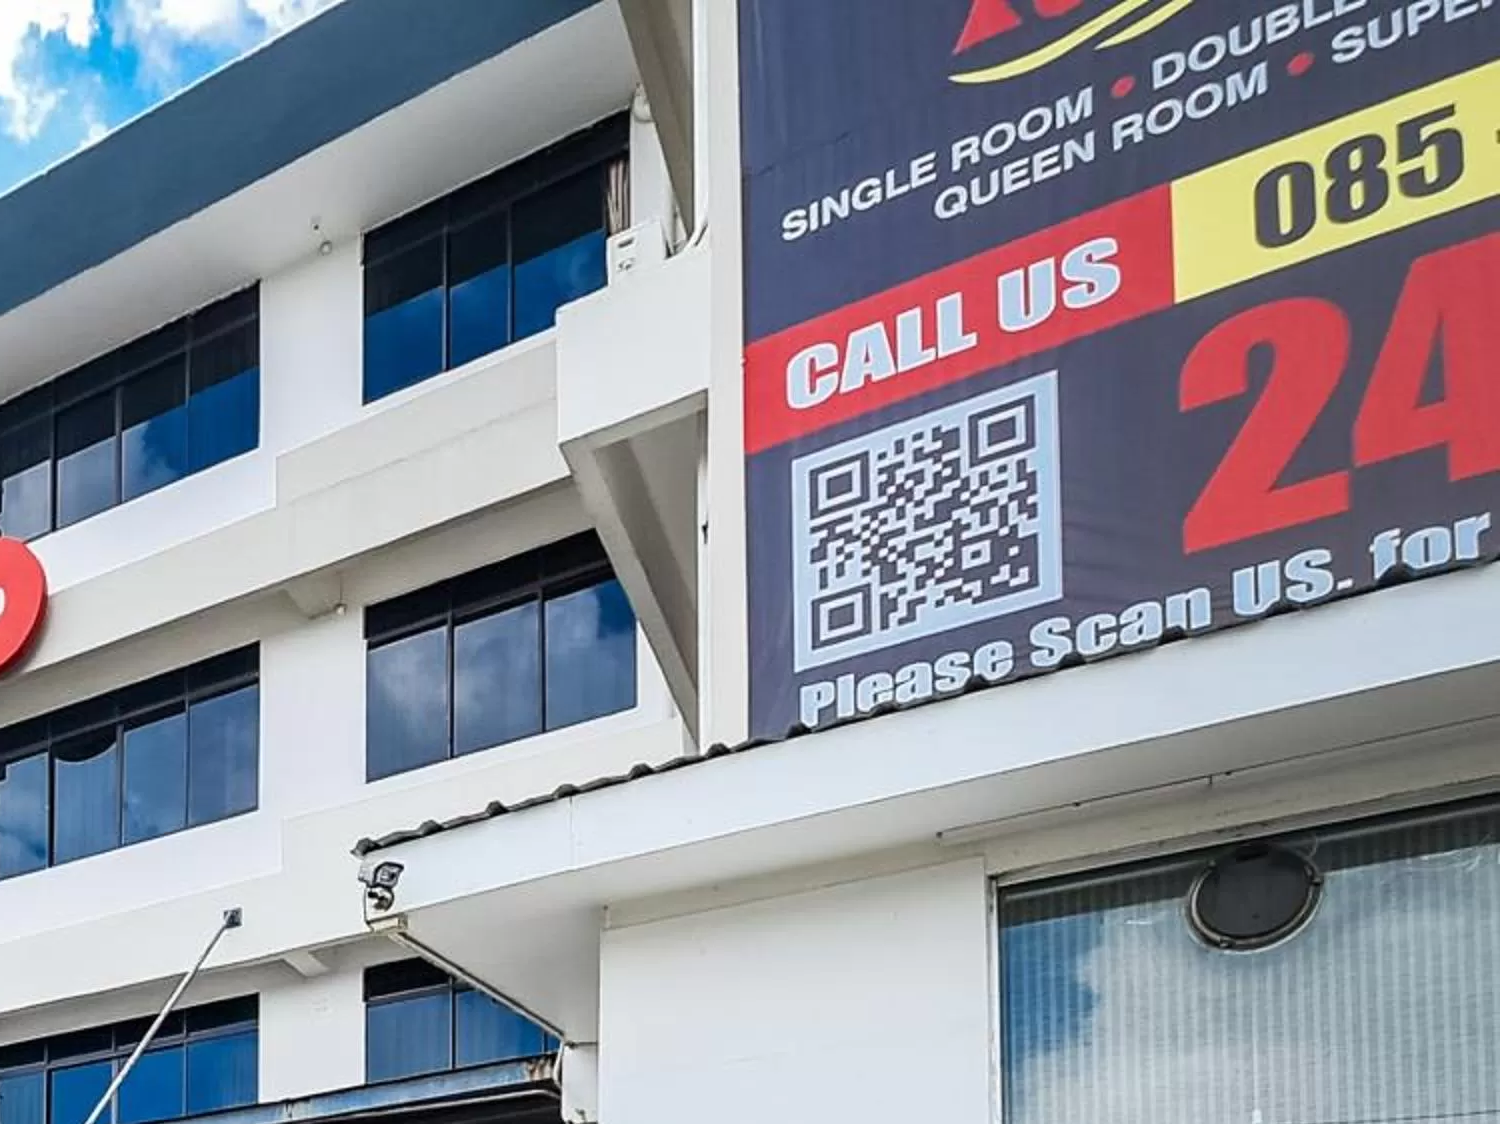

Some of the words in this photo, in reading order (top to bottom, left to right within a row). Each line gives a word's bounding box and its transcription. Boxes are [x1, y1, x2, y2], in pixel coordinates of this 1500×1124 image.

[781, 150, 937, 242] SINGLE
[951, 87, 1094, 172] ROOM
[933, 132, 1095, 221] QUEEN
[1112, 61, 1269, 151] ROOM
[1330, 0, 1495, 64] SUPE
[1253, 102, 1466, 250] 085
[785, 291, 978, 411] CALL
[997, 236, 1122, 334] US
[1178, 231, 1500, 556] 24
[799, 637, 1015, 728] Please
[1029, 585, 1212, 669] Scan
[1368, 511, 1492, 581] for
